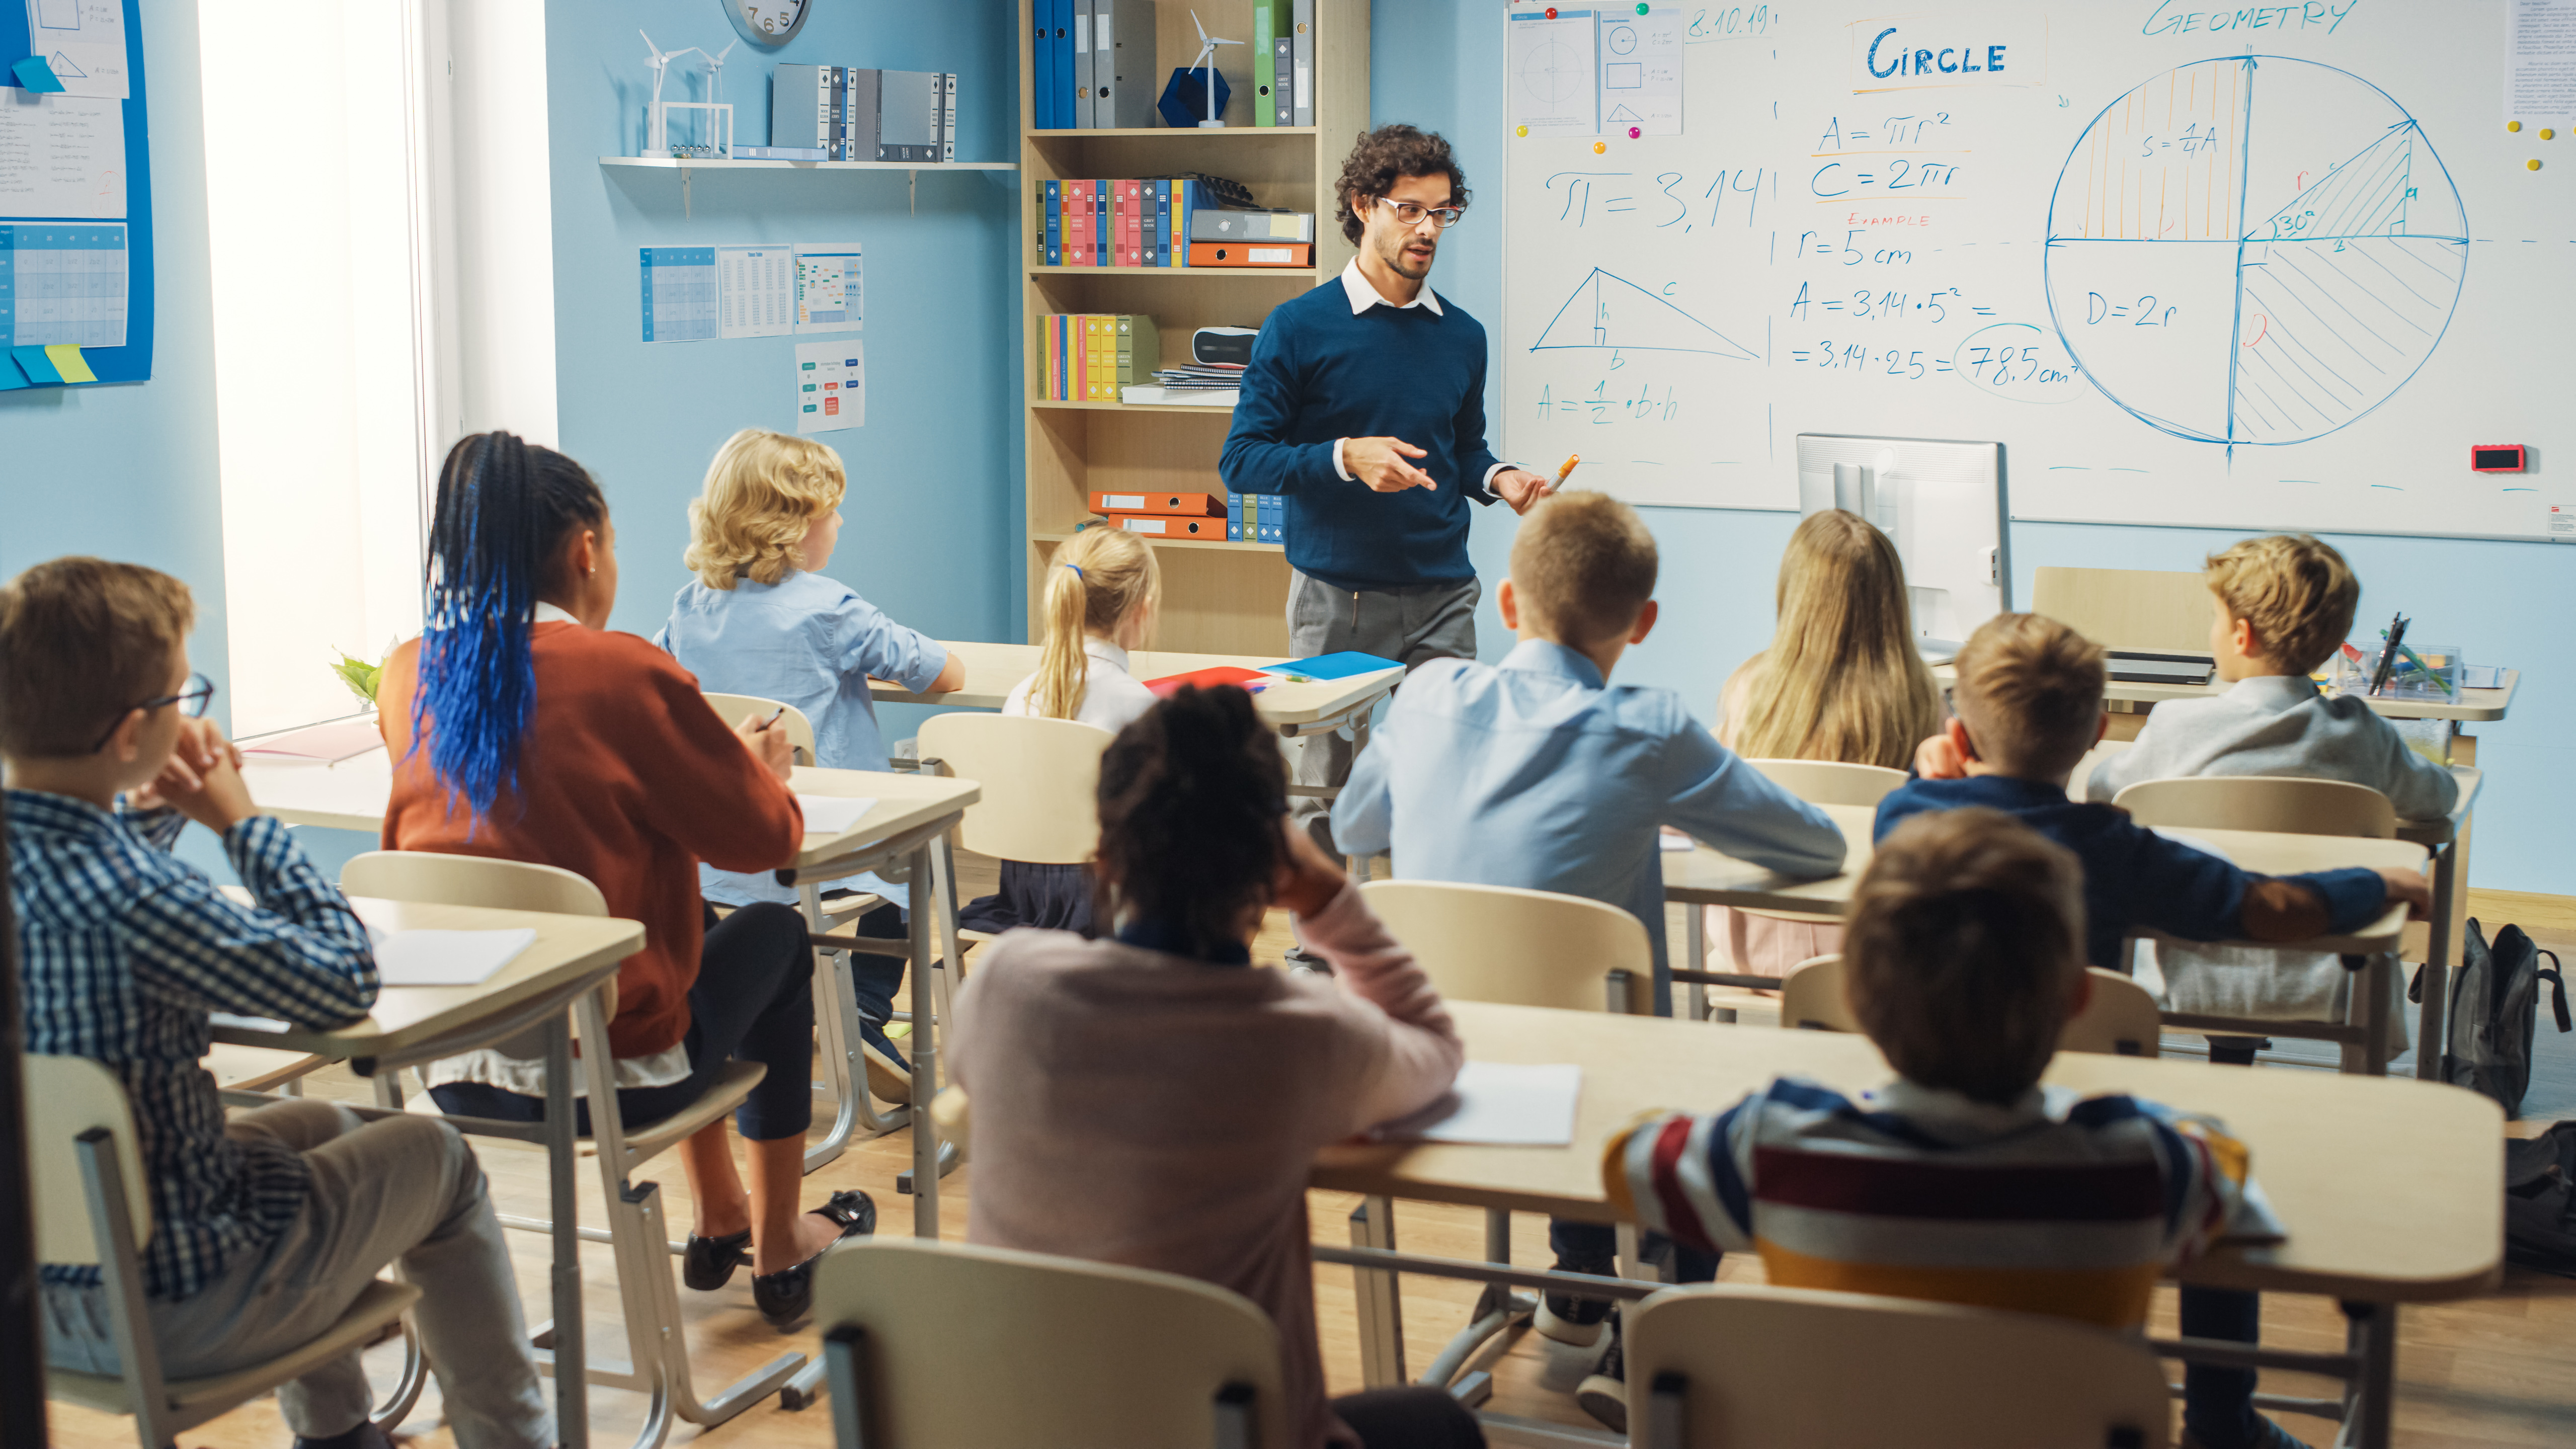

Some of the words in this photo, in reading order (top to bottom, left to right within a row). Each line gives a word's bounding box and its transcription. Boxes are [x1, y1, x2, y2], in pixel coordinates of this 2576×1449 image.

[749, 7, 758, 20] 7
[764, 18, 774, 33] 6
[780, 12, 789, 27] 5
[2142, 0, 2357, 35] GEOMETRY
[1818, 117, 1840, 151] A
[1811, 163, 1849, 196] C
